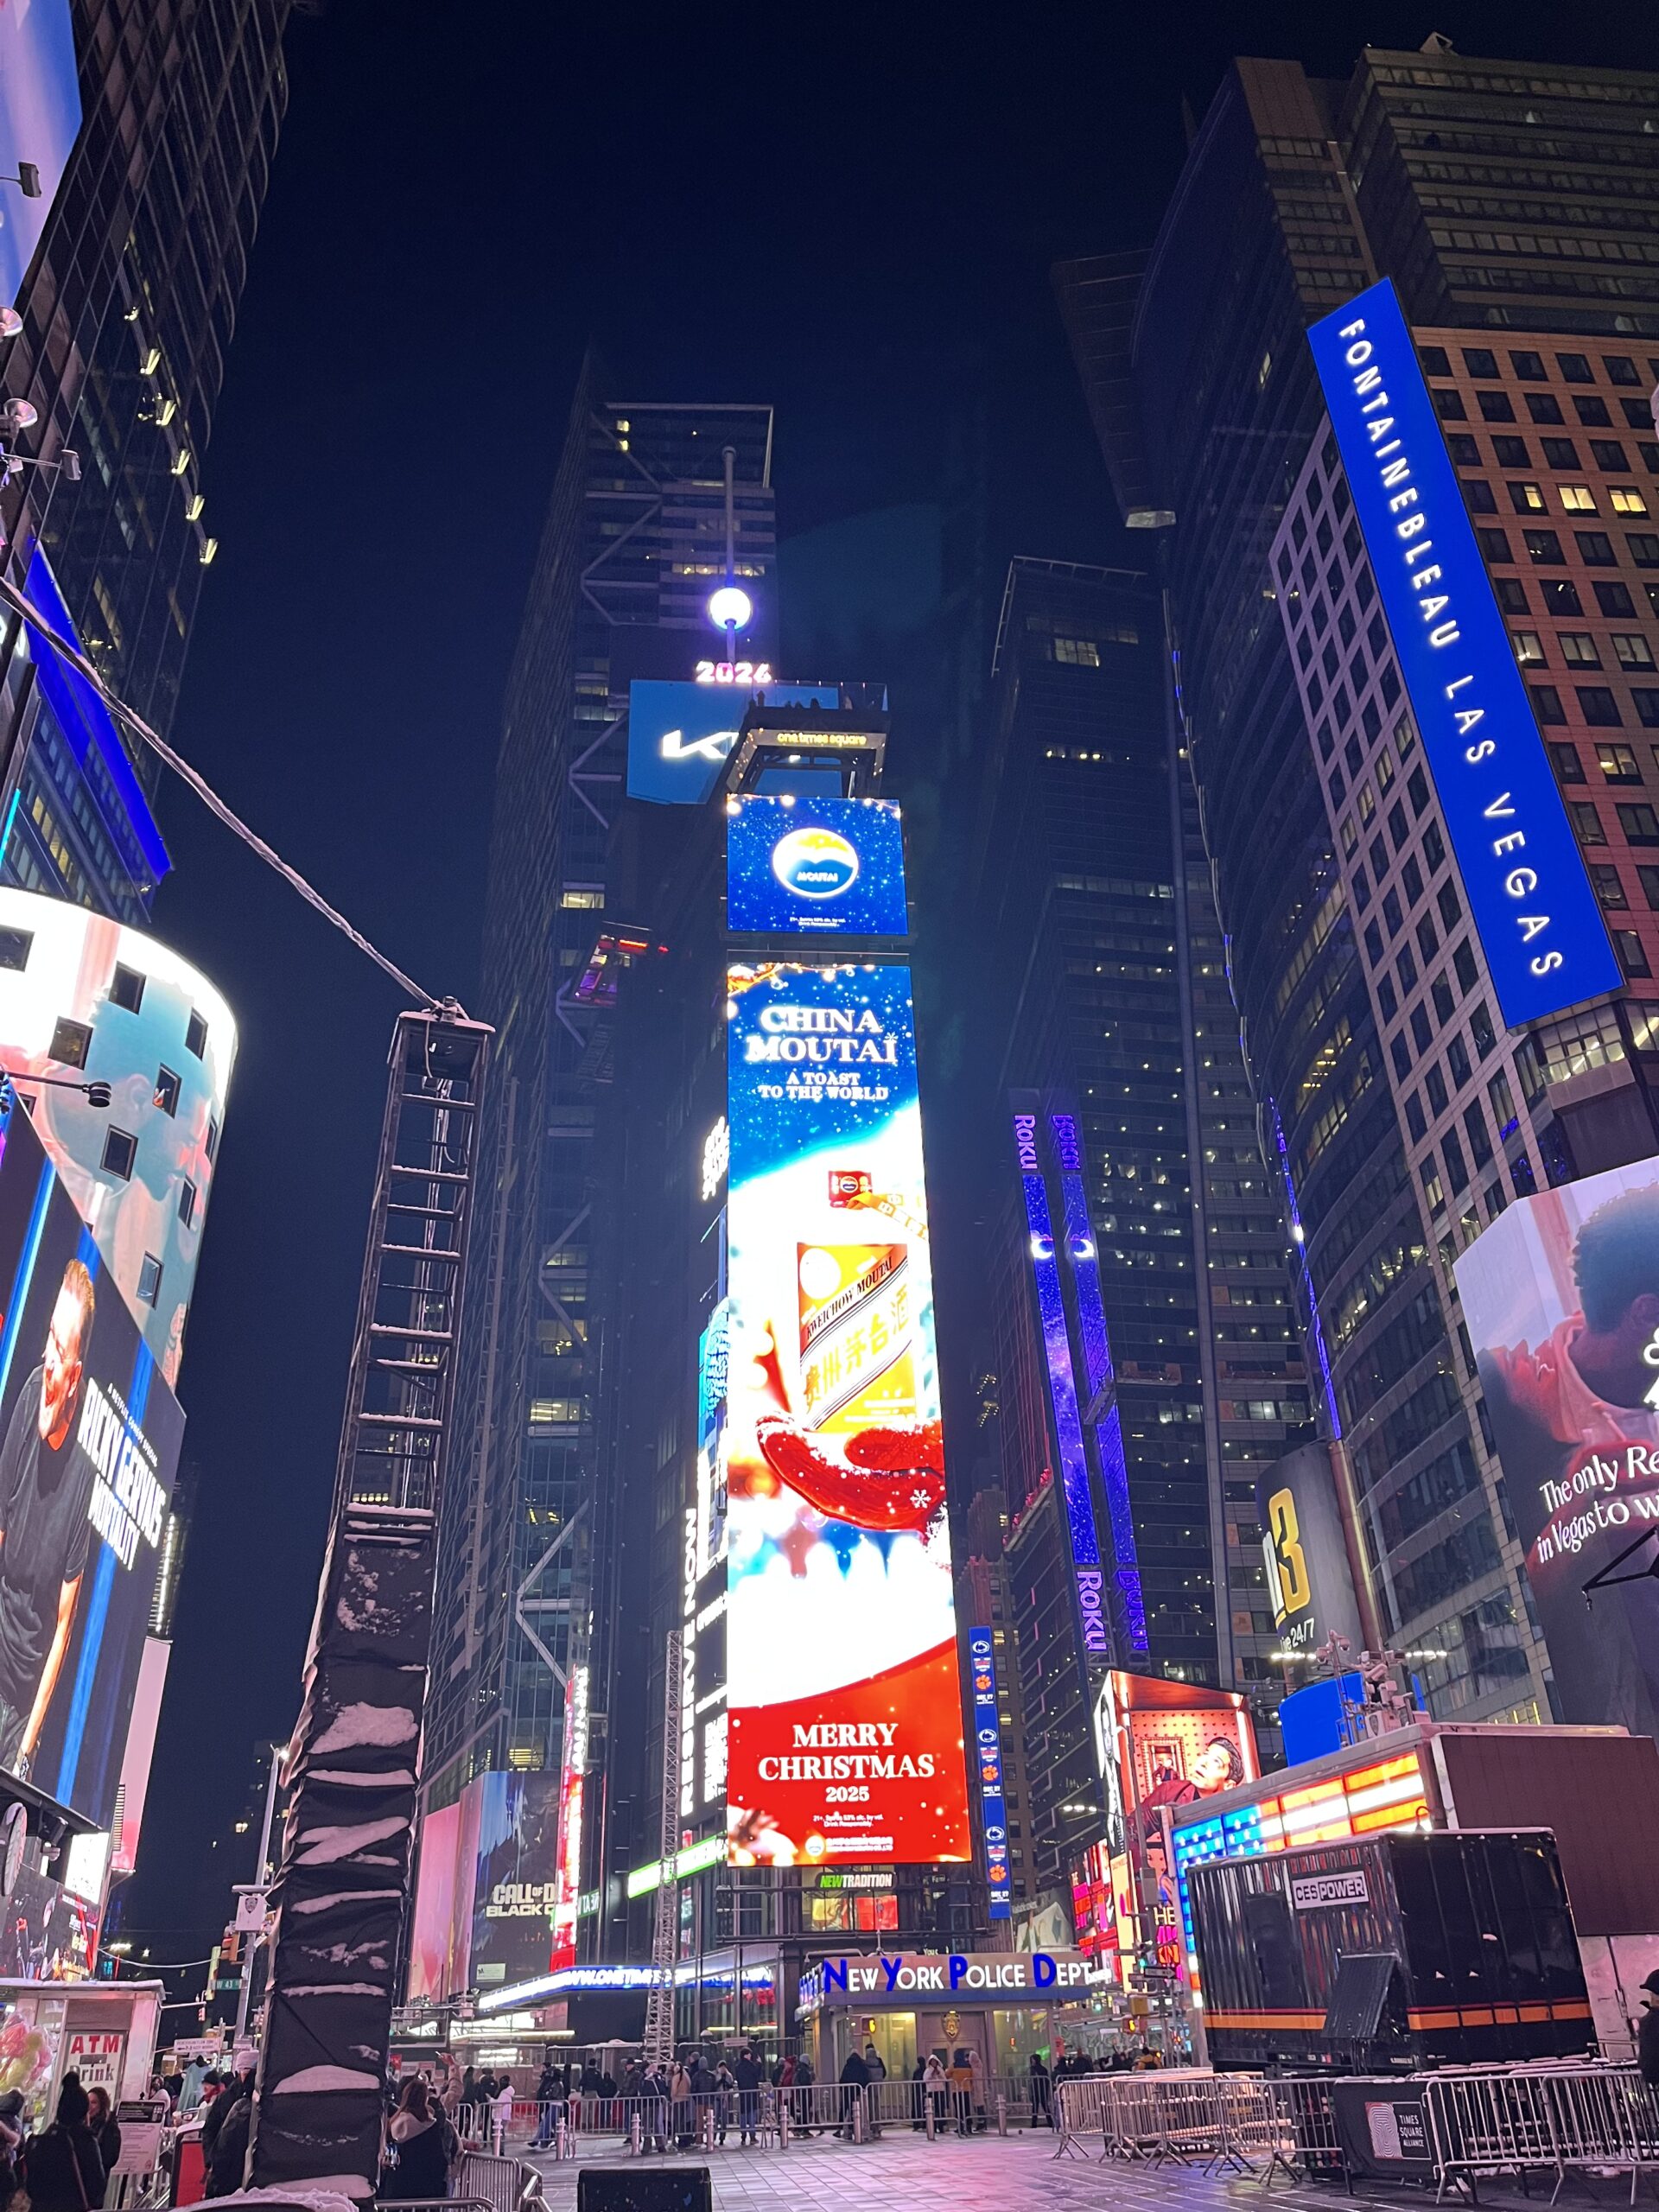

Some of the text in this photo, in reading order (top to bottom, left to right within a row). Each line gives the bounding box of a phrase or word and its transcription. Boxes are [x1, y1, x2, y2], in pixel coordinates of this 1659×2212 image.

[1337, 317, 1565, 977] FONTAINEBLEAU LAS VEGAS
[696, 661, 772, 683] 2026
[760, 1007, 883, 1033] CHINA
[745, 1035, 899, 1064] MOUTAI
[759, 1084, 888, 1101] TO THE WORLD
[787, 1071, 861, 1087] A TOAST
[1014, 1115, 1038, 1169] ROKU
[805, 1255, 893, 1338] KWEICHOW MOUTAI
[804, 1284, 910, 1414] 贵州茅台酒
[77, 1376, 167, 1548] RICKY GERVAIS
[1539, 1479, 1572, 1513] The
[1572, 1454, 1618, 1495] only
[87, 1473, 141, 1572] MORTALITY
[1537, 1535, 1554, 1564] in
[1552, 1510, 1597, 1554] Vegas
[1593, 1500, 1630, 1529] to
[1077, 1571, 1107, 1650] ROKU
[1291, 1617, 1315, 1649] 24/7
[680, 1507, 697, 1817] RESERVE NOW
[792, 1722, 899, 1748] MERRY
[758, 1753, 935, 1781] CHRISTMAS
[825, 1786, 870, 1802] 2025
[493, 1883, 535, 1905] CALL
[532, 1886, 543, 1897] OF
[1296, 1878, 1365, 1901] CES POWER
[486, 1904, 543, 1917] BLACK
[823, 1958, 879, 1993] NEW
[880, 1956, 944, 1992] YORK
[949, 1955, 1026, 1991] POLICE
[71, 2035, 120, 2054] ATM
[1400, 2114, 1419, 2125] TIMES
[1400, 2126, 1424, 2139] SQUARE
